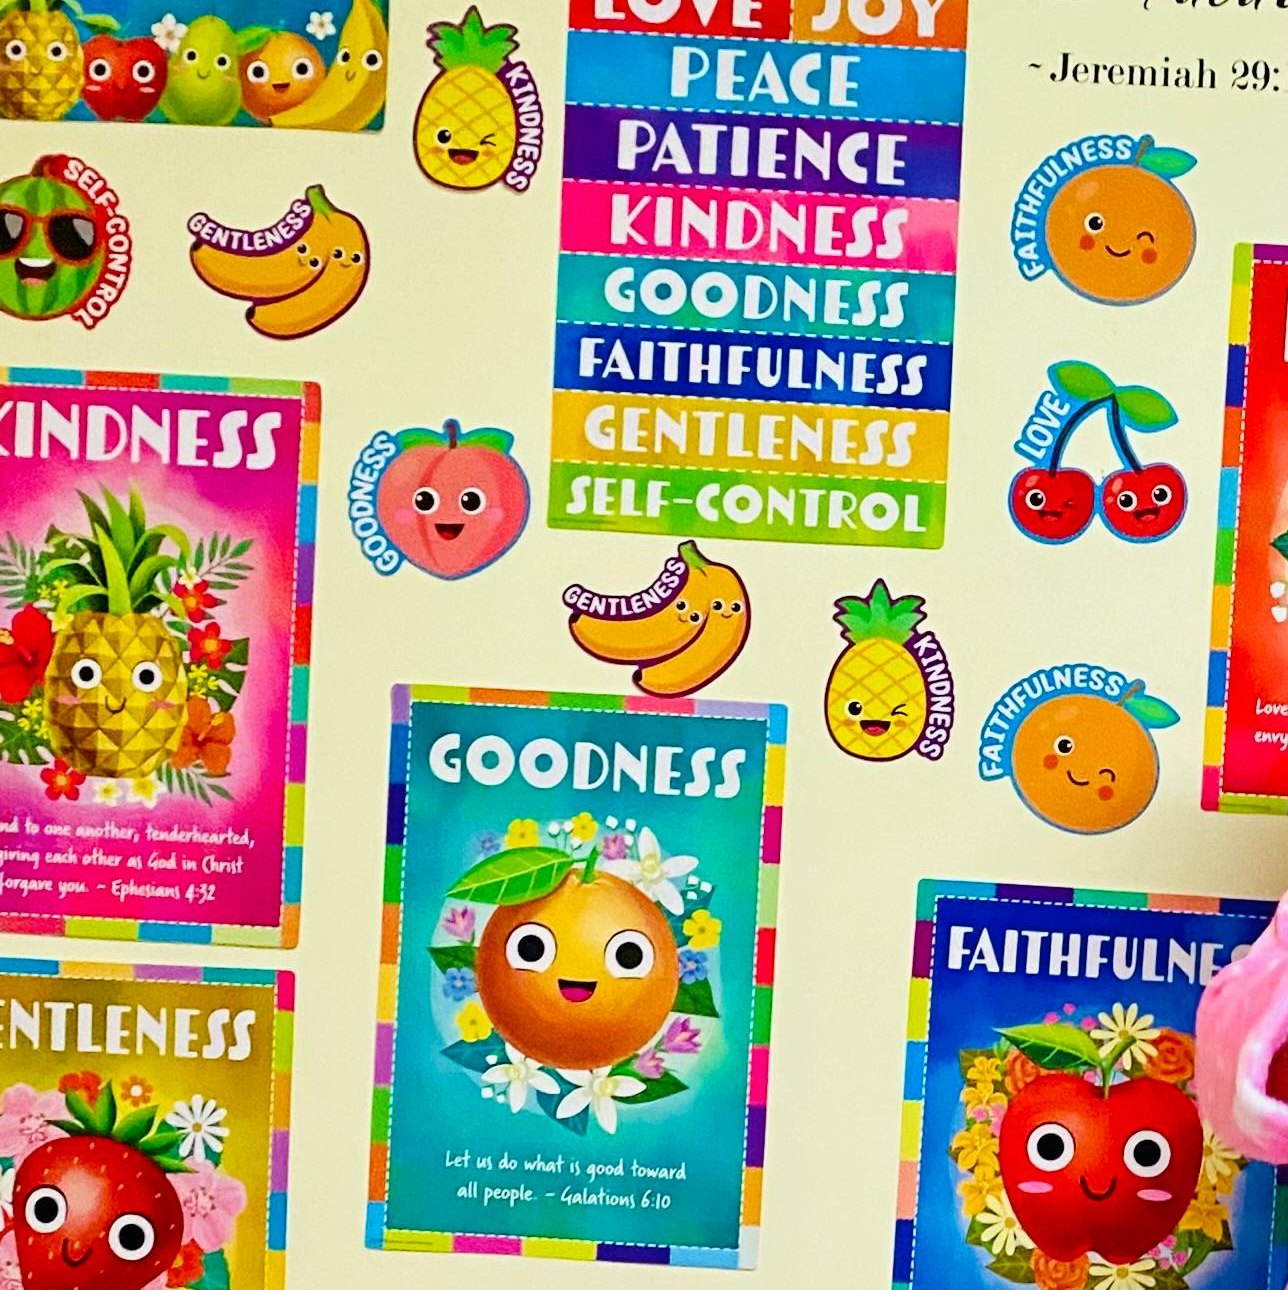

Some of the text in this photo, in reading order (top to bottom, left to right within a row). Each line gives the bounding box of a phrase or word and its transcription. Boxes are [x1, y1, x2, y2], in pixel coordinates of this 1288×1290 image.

[671, 46, 860, 107] PEACE
[505, 67, 539, 189] KINDNESS
[614, 117, 909, 188] PATIENCE
[187, 202, 310, 252] GENTLENESS
[608, 193, 909, 259] KINDNESS
[1012, 137, 1132, 276] FAITHFULNESS
[62, 157, 130, 327] SELF-CONTROL
[604, 267, 909, 330] GOODNESS
[578, 337, 928, 397] FAITHFULNESS
[583, 403, 917, 468] GENTLENESS
[1017, 392, 1071, 461] LOVE
[352, 437, 400, 572] GOODNESS
[566, 474, 928, 532] SELF-CONTROL
[563, 559, 688, 618] GENTLENESS
[915, 635, 955, 759] KINDNESS
[980, 668, 1125, 779] FAITHFULNESS
[429, 733, 746, 798] GOODNESS
[0, 998, 256, 1061] NTLENESS
[445, 1150, 686, 1182] Let us do what is good toward
[457, 1181, 477, 1198] all
[483, 1184, 538, 1207] people.
[641, 1190, 671, 1209] 6:10
